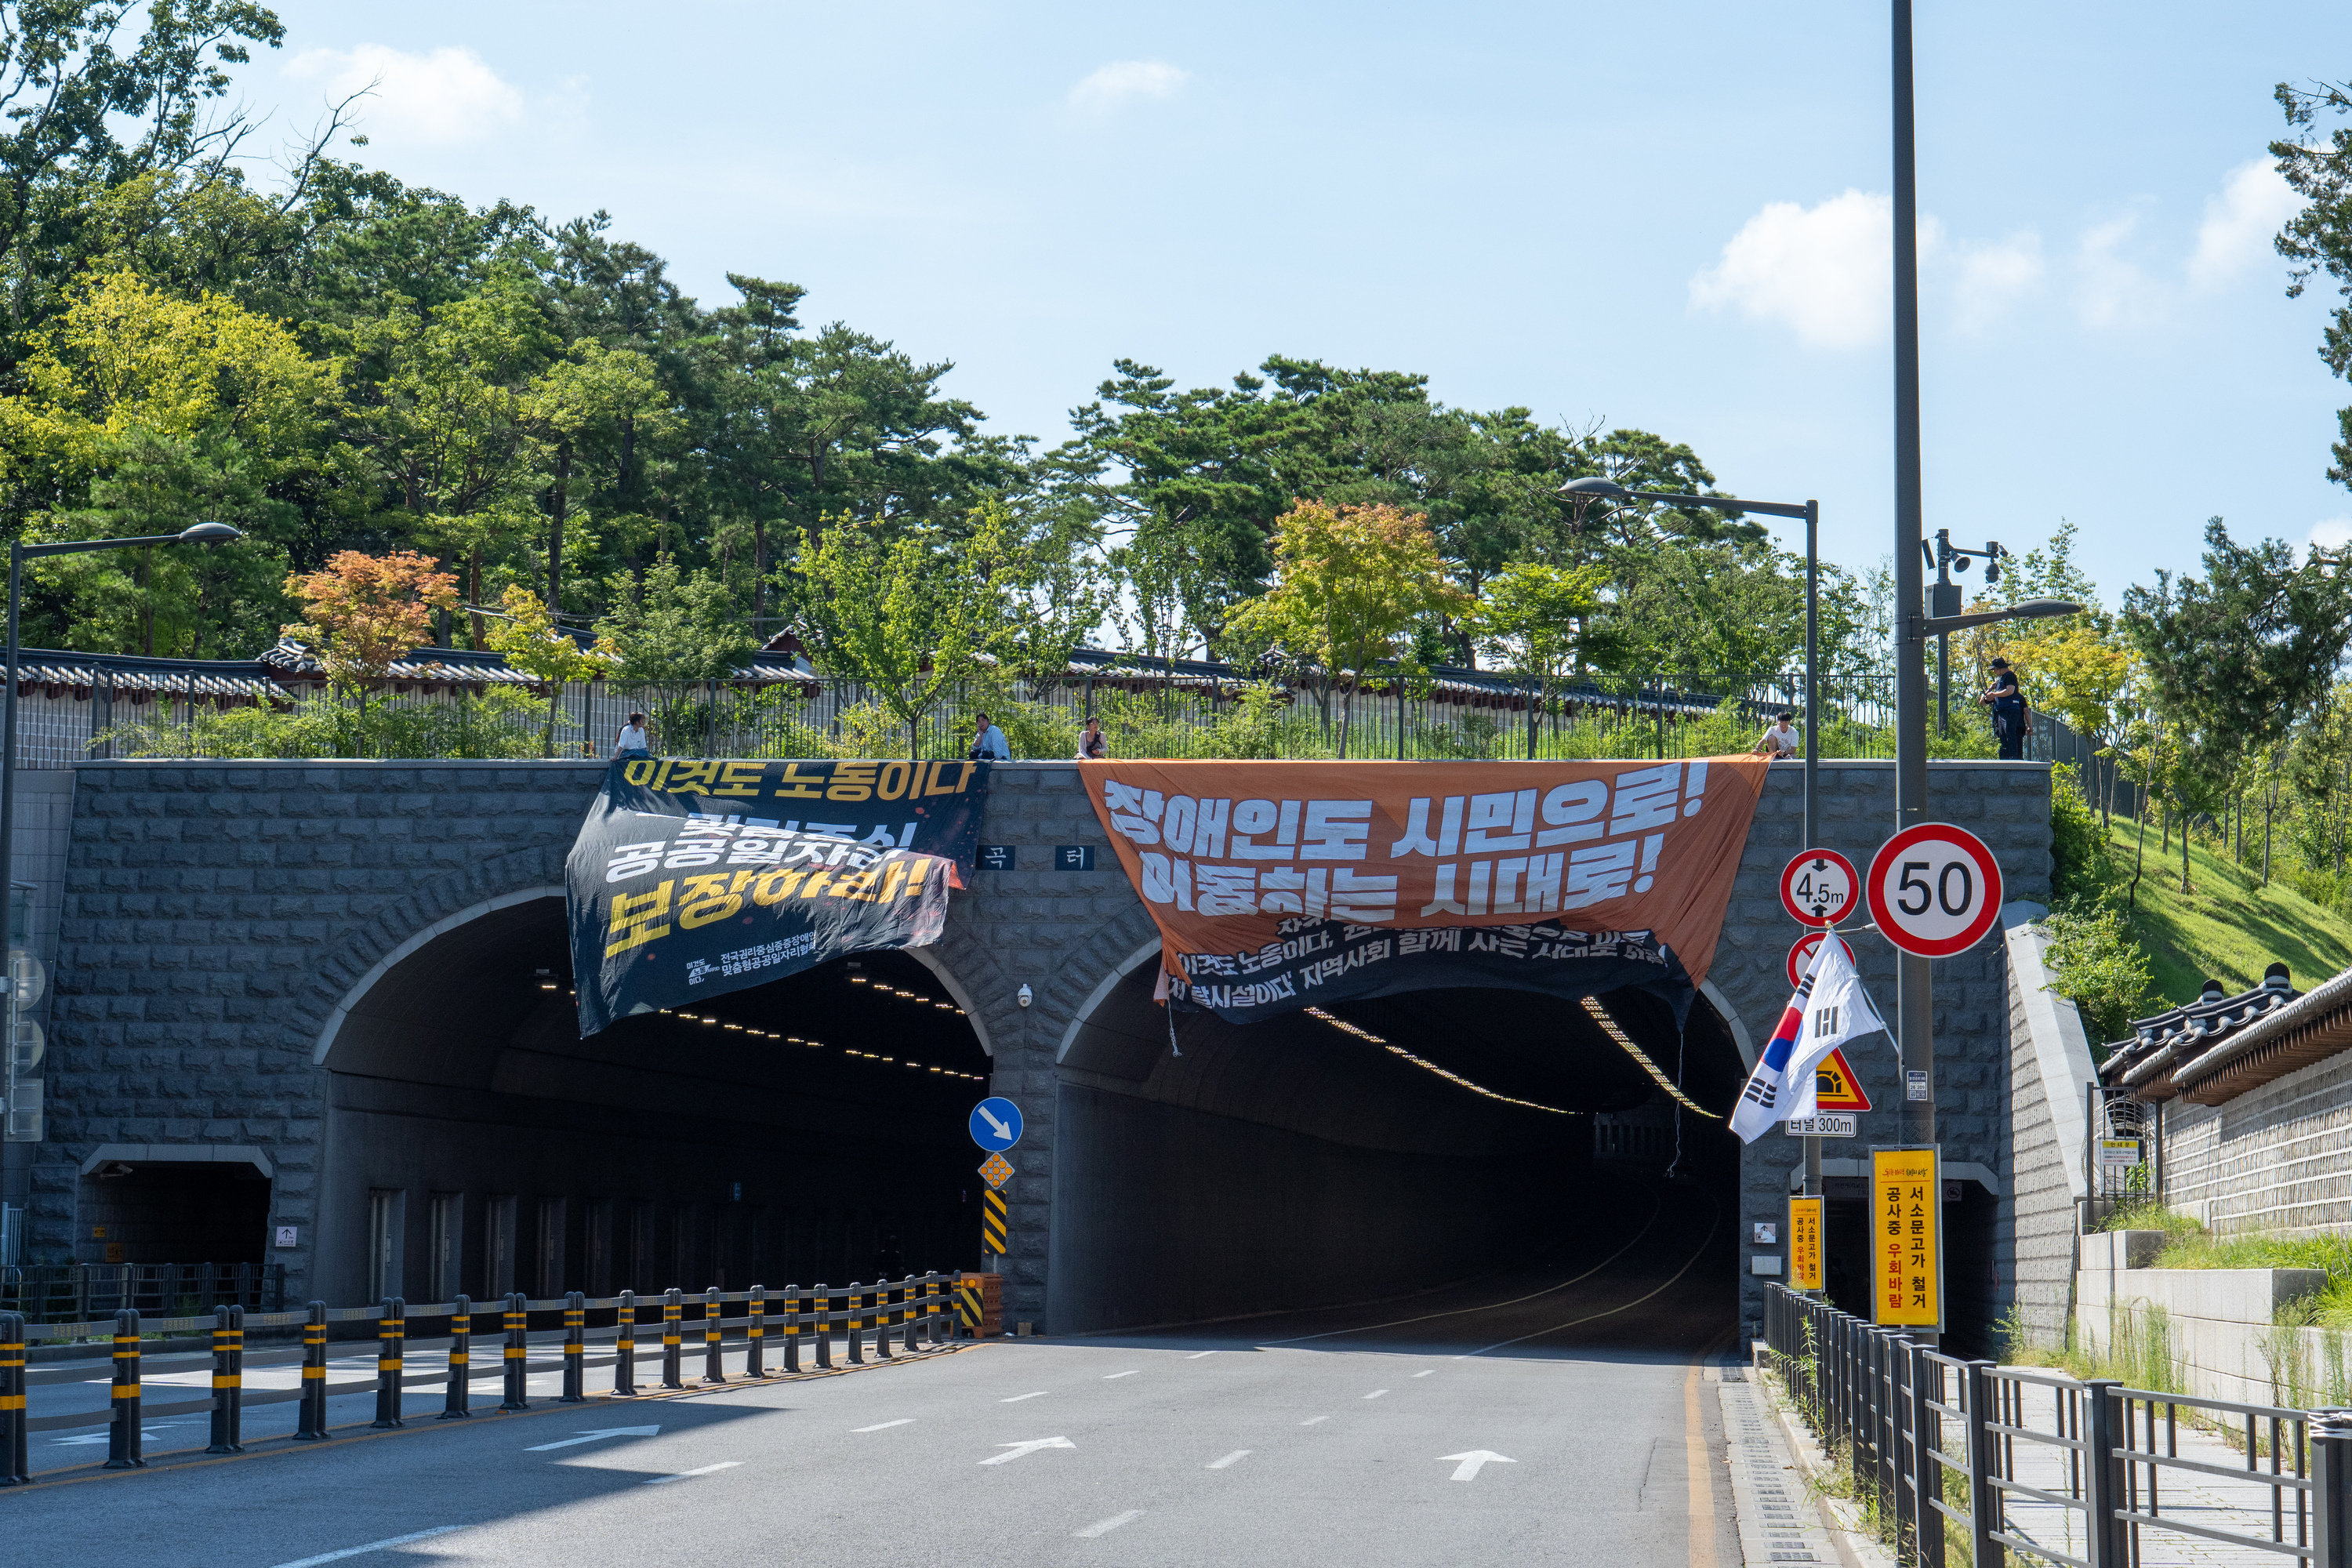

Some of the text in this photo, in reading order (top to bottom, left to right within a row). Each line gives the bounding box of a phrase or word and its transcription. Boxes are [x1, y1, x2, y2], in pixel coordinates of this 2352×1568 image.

[624, 760, 977, 801] 이것도 노동이다
[1105, 760, 1709, 860] 장애인도 시민으로!
[985, 847, 1084, 870] 곡 터
[1138, 833, 1664, 923] 이동하는 시대로!
[606, 858, 932, 959] 보장하라!
[1796, 873, 1844, 904] 4.5m
[1897, 861, 1973, 916] 50
[1239, 930, 1334, 975] 노동이다,
[1299, 938, 1391, 989] 지역사회
[1399, 930, 1461, 955] 함께
[1468, 932, 1528, 959] 사는
[1819, 1117, 1852, 1132] 300m
[1886, 1187, 1903, 1308] 공사중 우회바람
[1910, 1186, 1926, 1308] 서소문고가 철거
